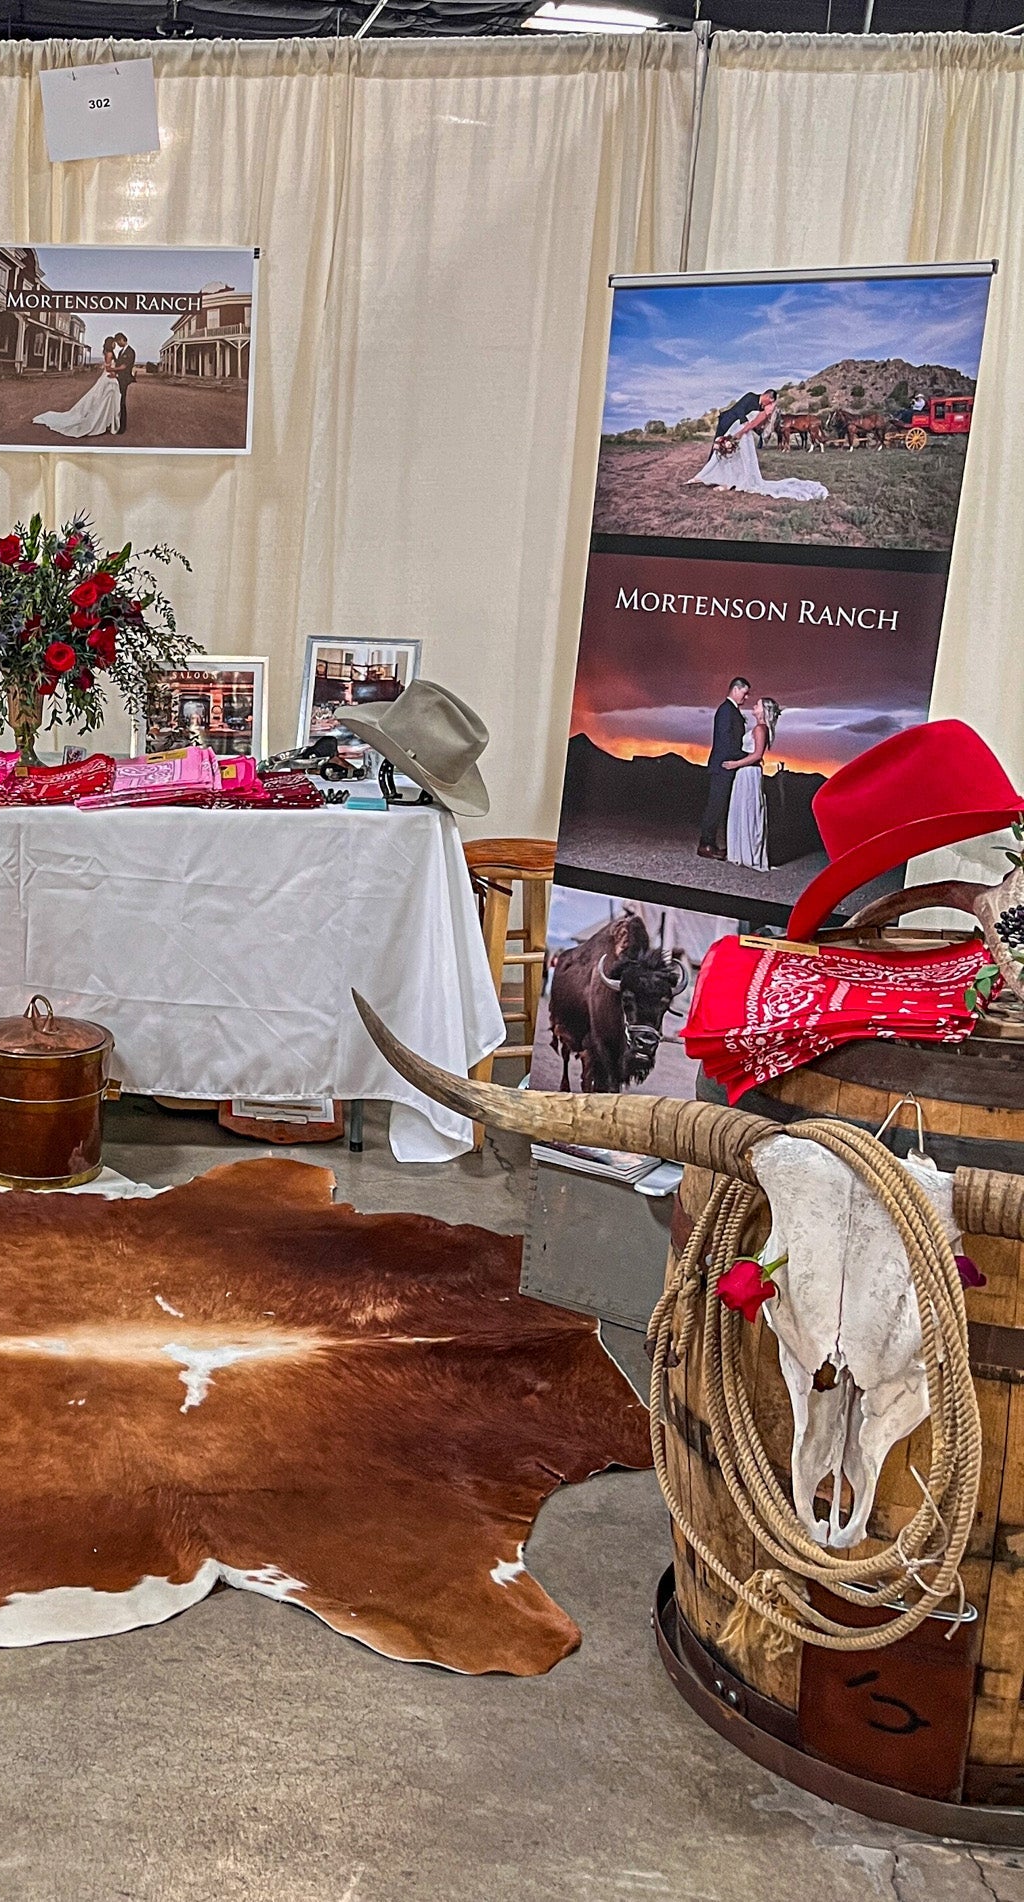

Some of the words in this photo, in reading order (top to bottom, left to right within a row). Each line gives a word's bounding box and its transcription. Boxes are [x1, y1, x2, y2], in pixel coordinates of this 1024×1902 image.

[88, 98, 111, 109] 302
[6, 291, 128, 310] MORTENSON
[135, 294, 202, 312] RANCH
[615, 587, 788, 622] MORTENSON
[798, 599, 900, 631] RANCH
